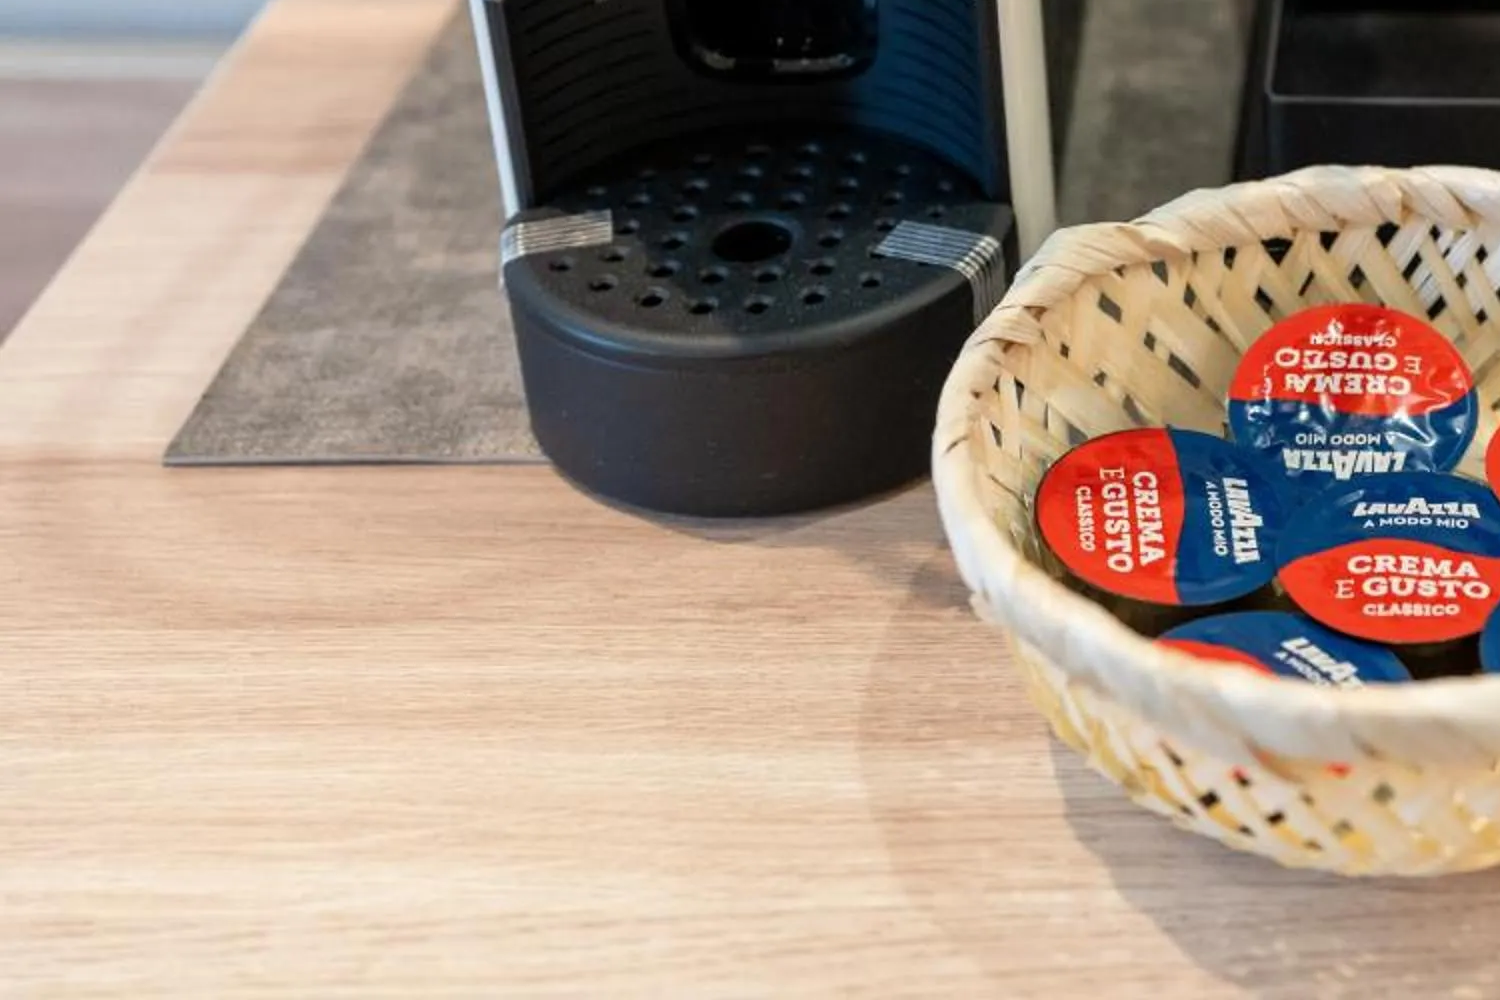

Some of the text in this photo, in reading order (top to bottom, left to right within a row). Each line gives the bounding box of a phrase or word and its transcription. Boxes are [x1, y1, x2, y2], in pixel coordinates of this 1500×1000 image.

[1274, 346, 1423, 375] E GUSTO
[1284, 372, 1412, 396] CREMA
[1295, 432, 1327, 446] MIO
[1330, 432, 1382, 446] MODO
[1075, 485, 1097, 552] CLASSICO
[1099, 466, 1135, 574] E GUSTO
[1132, 470, 1166, 567] CREMA
[1205, 480, 1229, 557] A MODO MIO
[1352, 497, 1481, 519] LAVAZZA
[1221, 476, 1265, 565] LAVAZZA
[1363, 516, 1469, 530] A MODO MIO
[1347, 554, 1481, 579] CREMA
[1334, 576, 1491, 600] E GUSTO
[1362, 602, 1461, 618] CLASSICO
